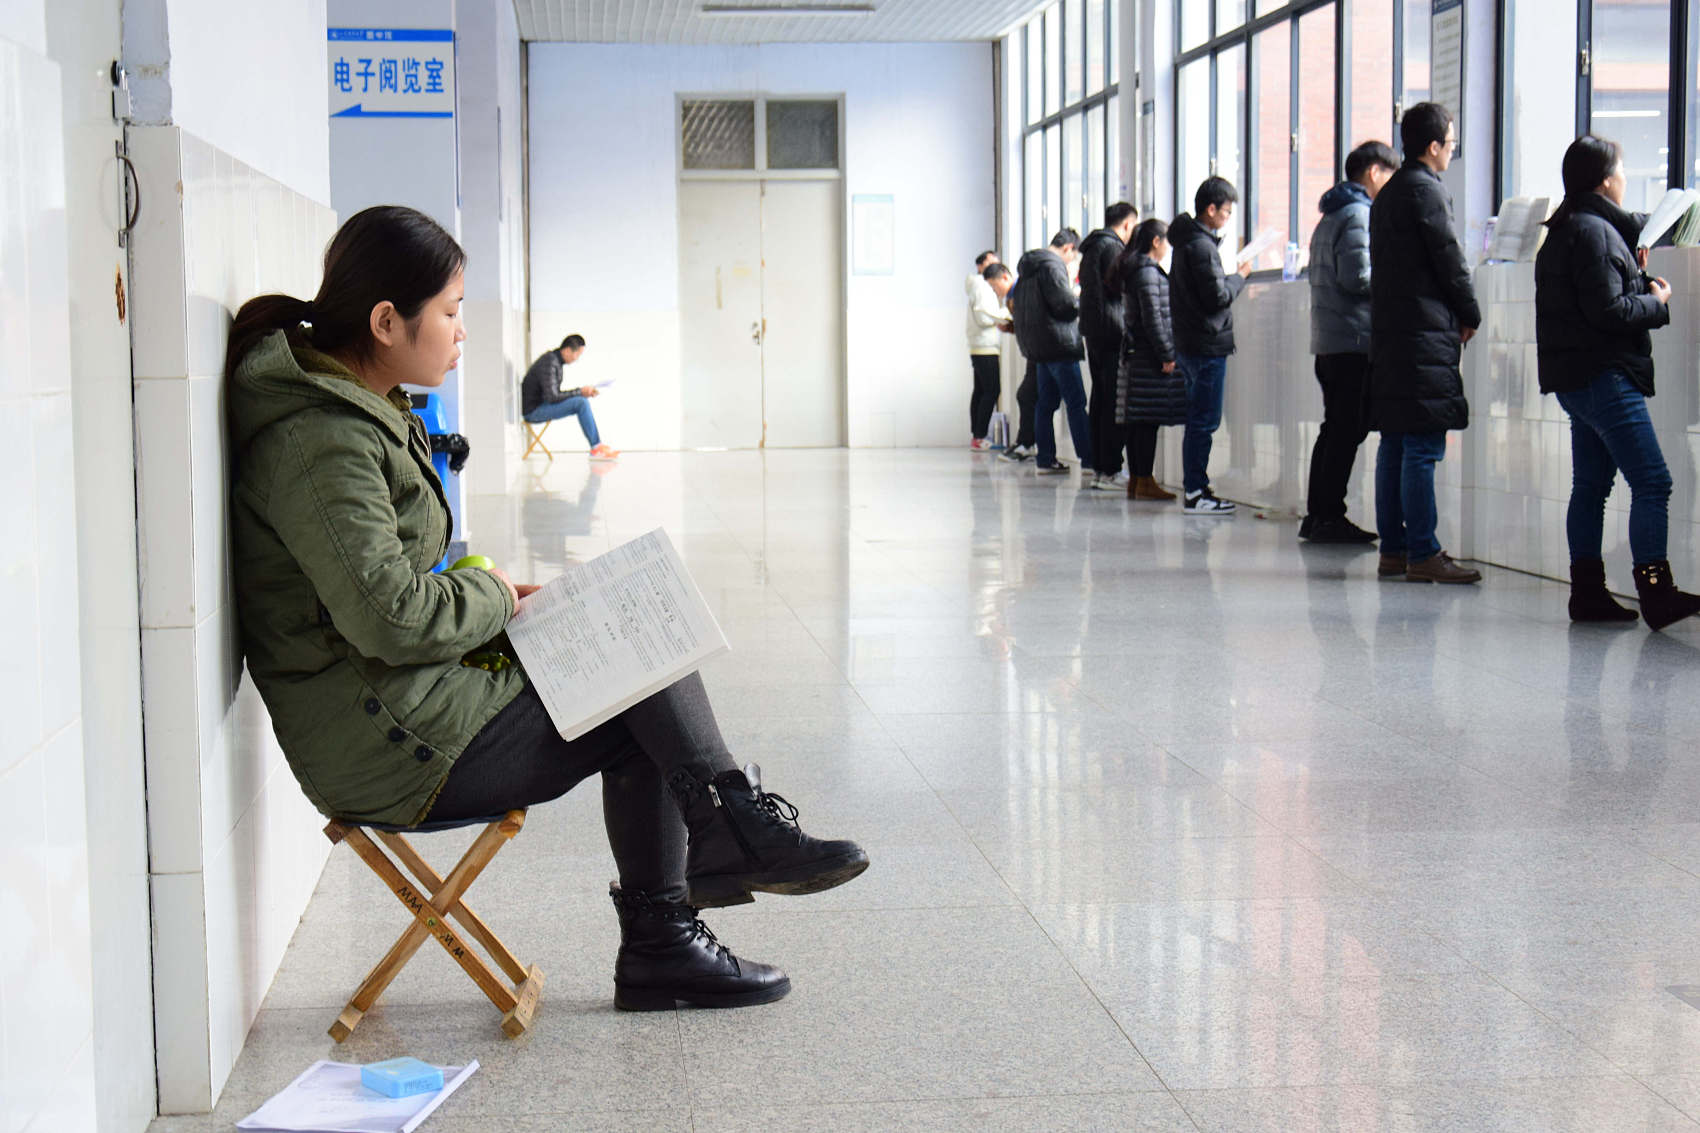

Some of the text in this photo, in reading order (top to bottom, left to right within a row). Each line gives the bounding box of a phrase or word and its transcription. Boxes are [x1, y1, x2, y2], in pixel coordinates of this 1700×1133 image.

[334, 57, 444, 94] 电子阅览室
